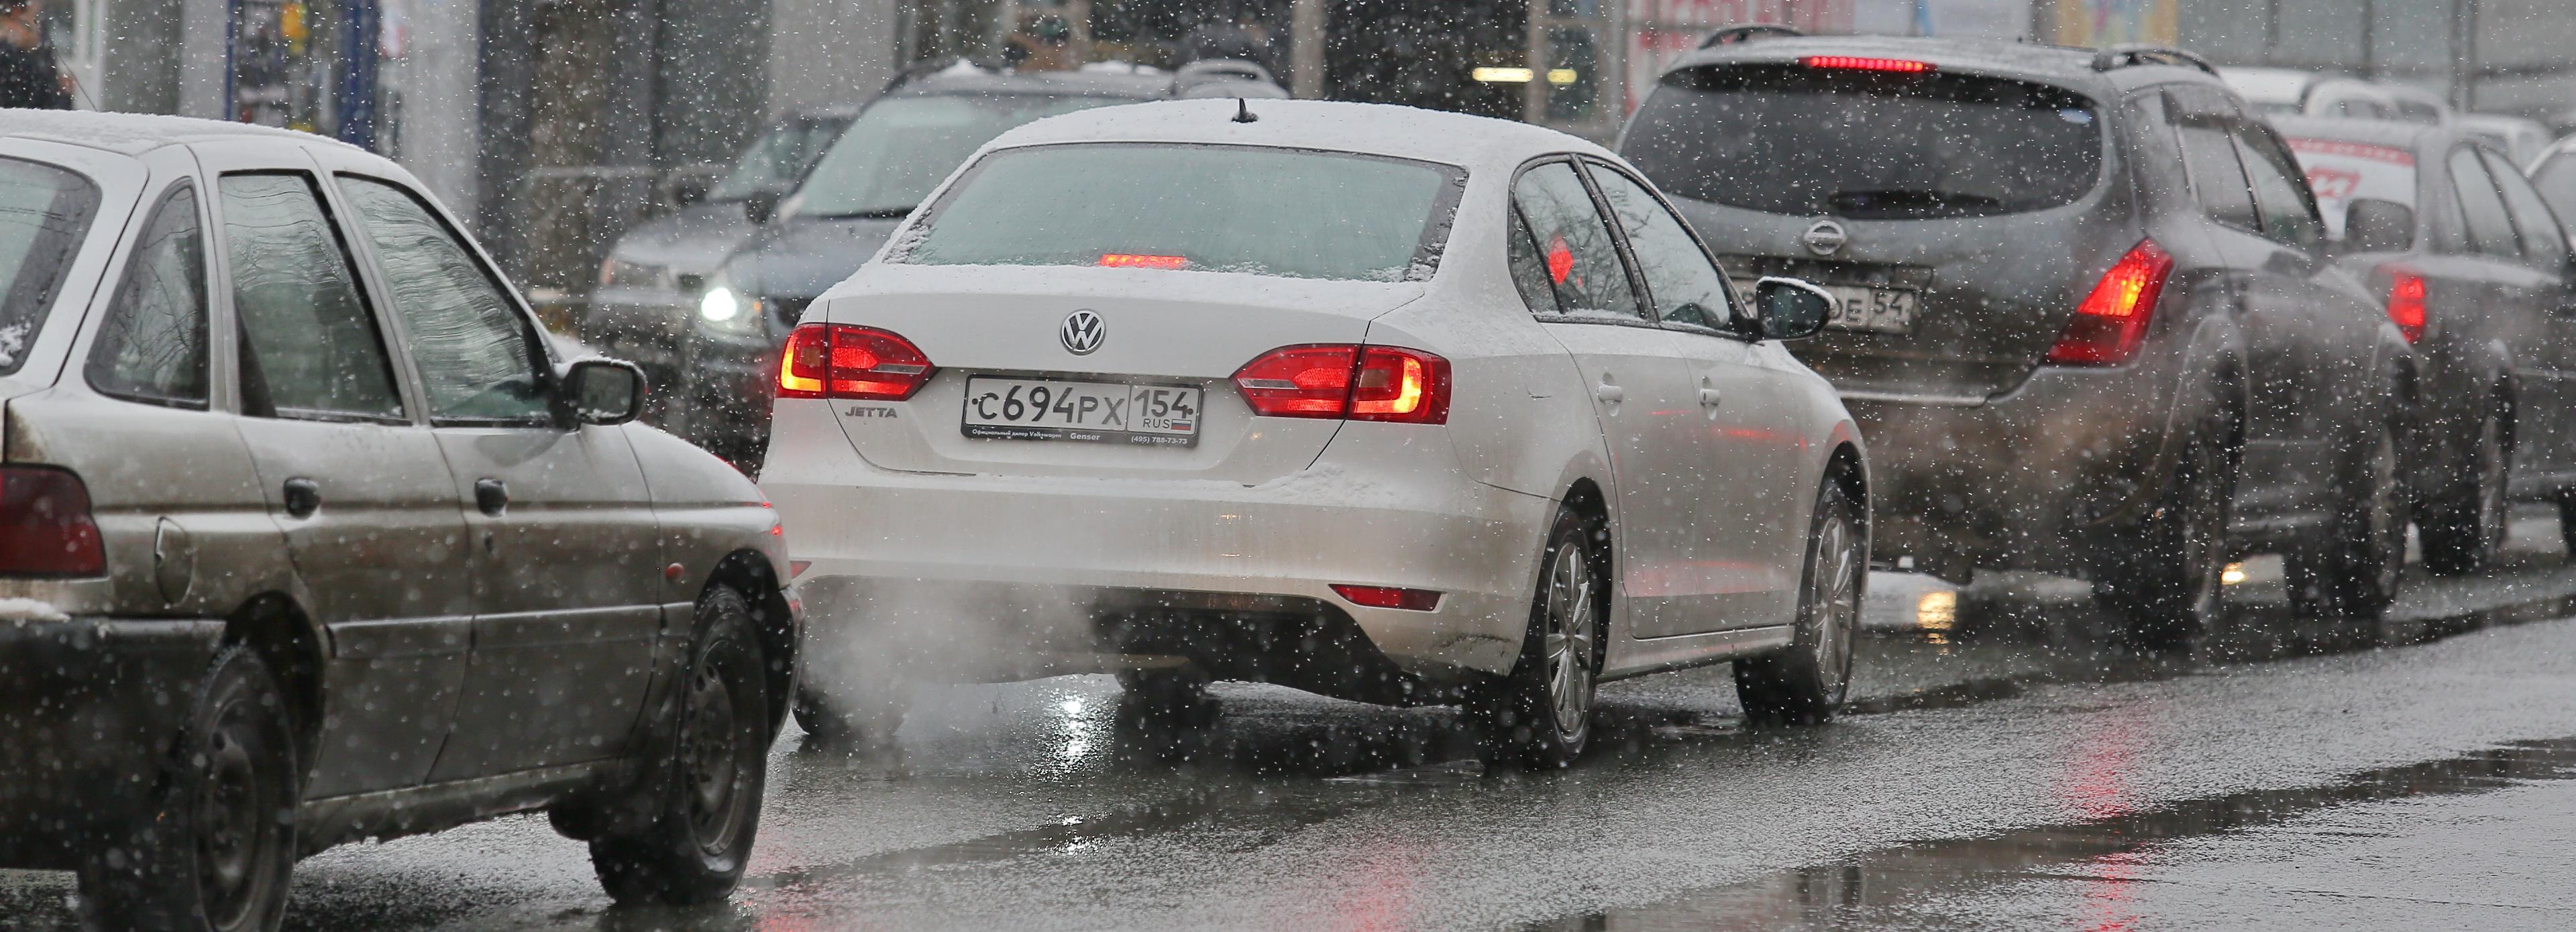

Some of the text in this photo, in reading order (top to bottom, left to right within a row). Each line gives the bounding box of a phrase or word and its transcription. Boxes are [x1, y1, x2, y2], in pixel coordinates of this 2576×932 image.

[1874, 292, 1904, 316] 54
[1134, 390, 1188, 419] 154
[845, 406, 898, 418] JETTA
[1142, 418, 1171, 429] RUS
[972, 428, 1011, 436] Официальный
[1070, 432, 1100, 441] Genser
